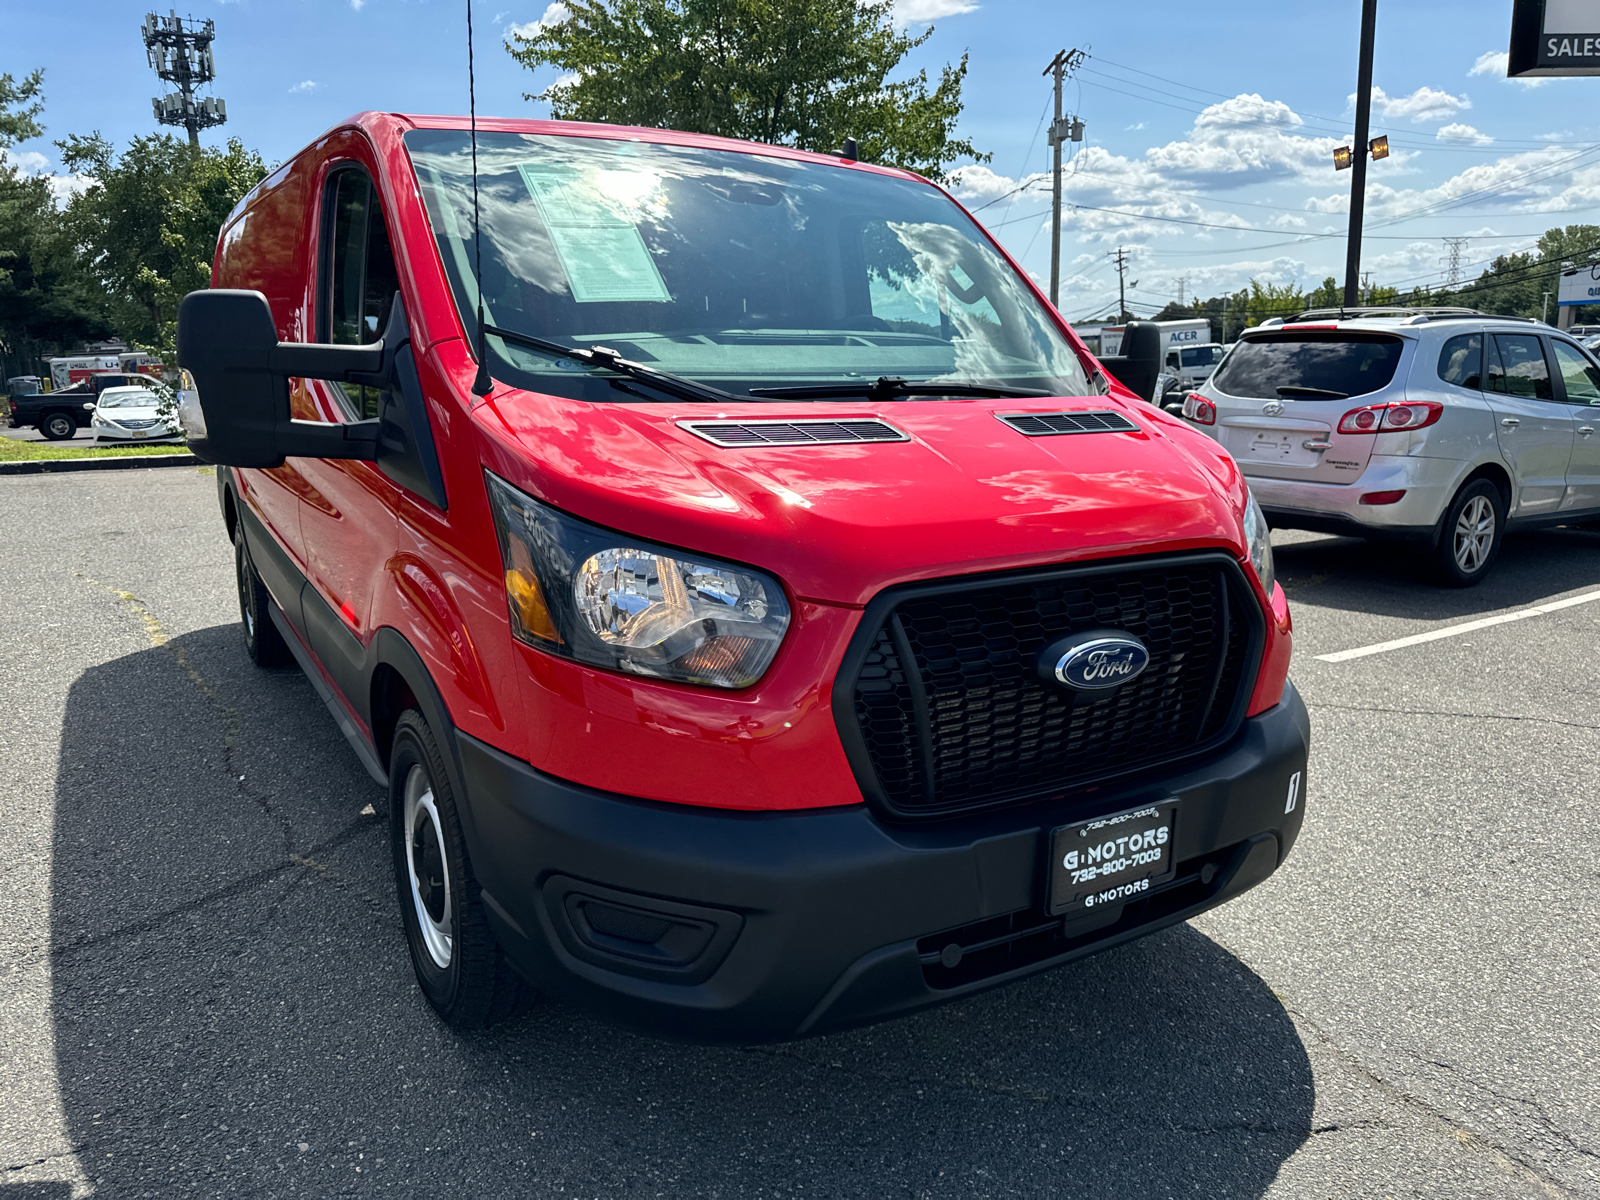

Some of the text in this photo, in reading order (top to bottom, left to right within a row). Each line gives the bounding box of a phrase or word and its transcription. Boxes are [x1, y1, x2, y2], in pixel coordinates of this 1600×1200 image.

[1170, 331, 1198, 342] ACER
[1083, 648, 1133, 680] Ford
[1086, 807, 1155, 831] 732-800-7003
[1070, 848, 1161, 885] 732-800-7003
